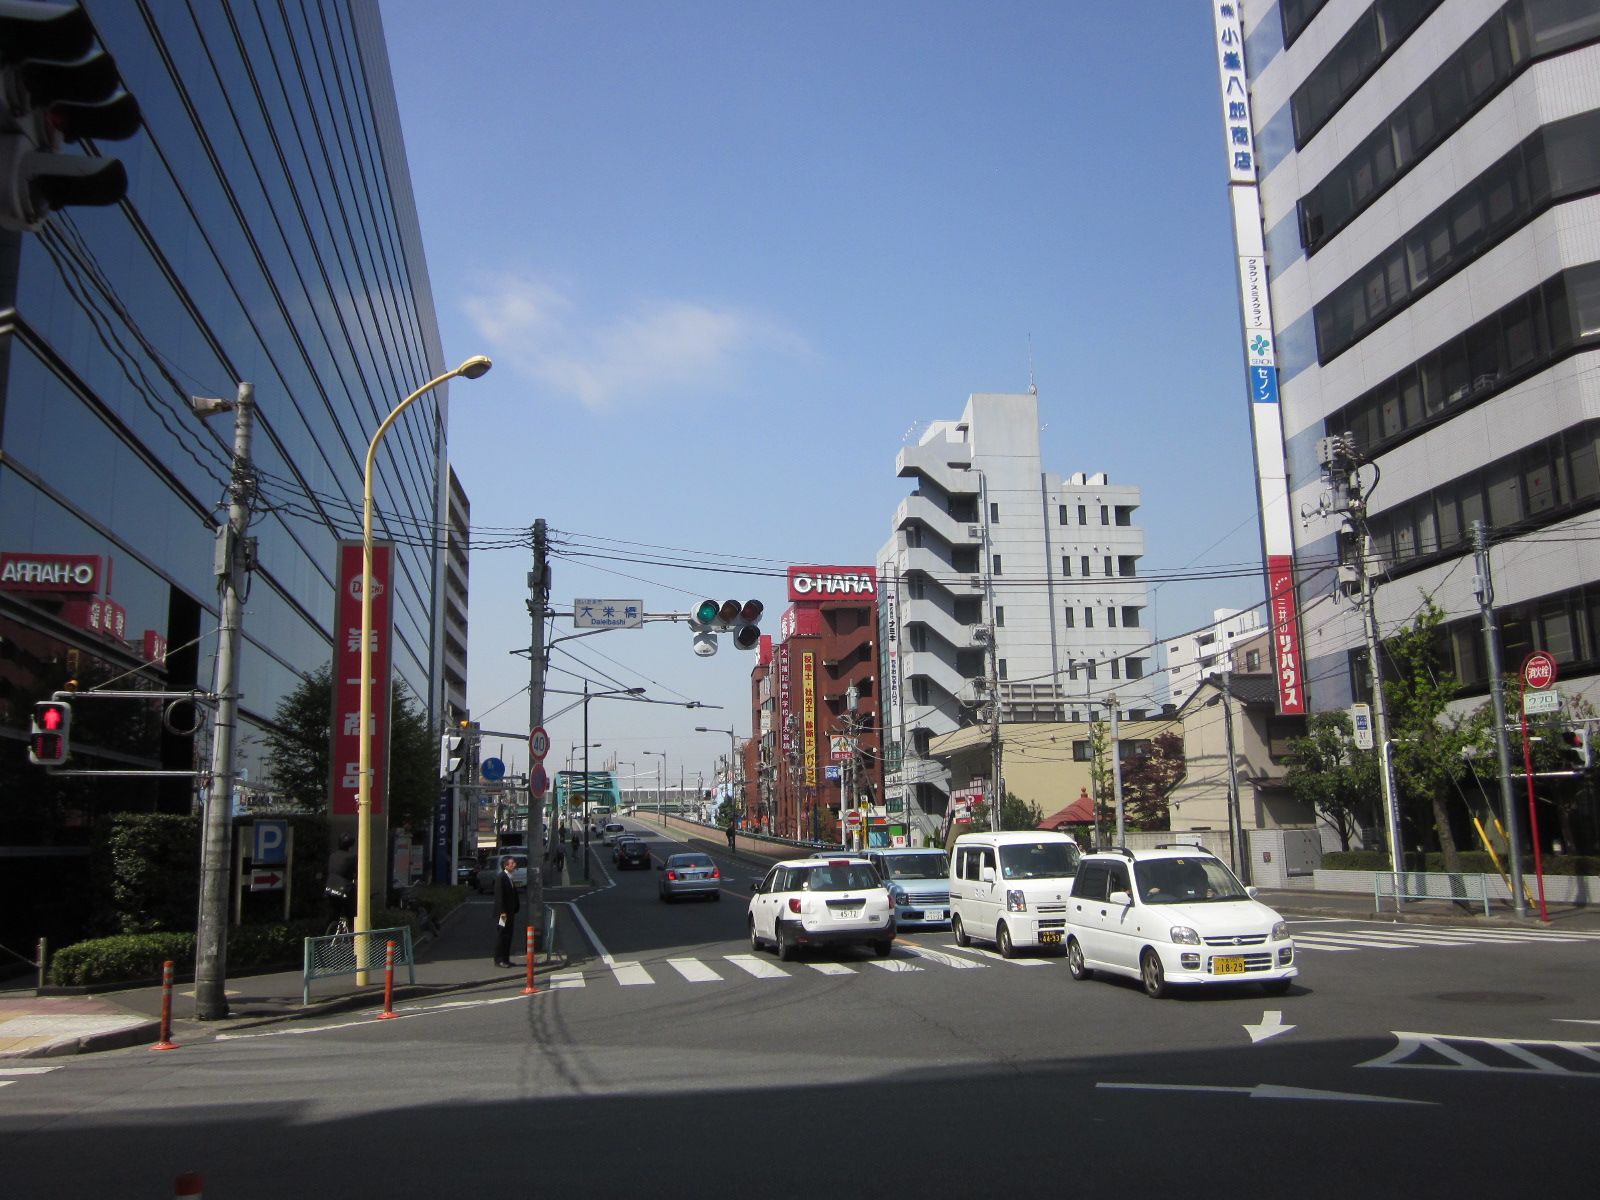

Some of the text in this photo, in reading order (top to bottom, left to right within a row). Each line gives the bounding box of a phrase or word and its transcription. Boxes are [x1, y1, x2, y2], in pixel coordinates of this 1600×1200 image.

[1258, 368, 1270, 400] セノン
[793, 573, 874, 593] O-HARA
[580, 606, 637, 619] 大栄橋
[1277, 598, 1298, 706] 三井のリハウス
[1528, 665, 1550, 679] 消火栓
[534, 736, 545, 752] 40
[258, 825, 283, 860] P
[1221, 962, 1243, 973] 18-29
